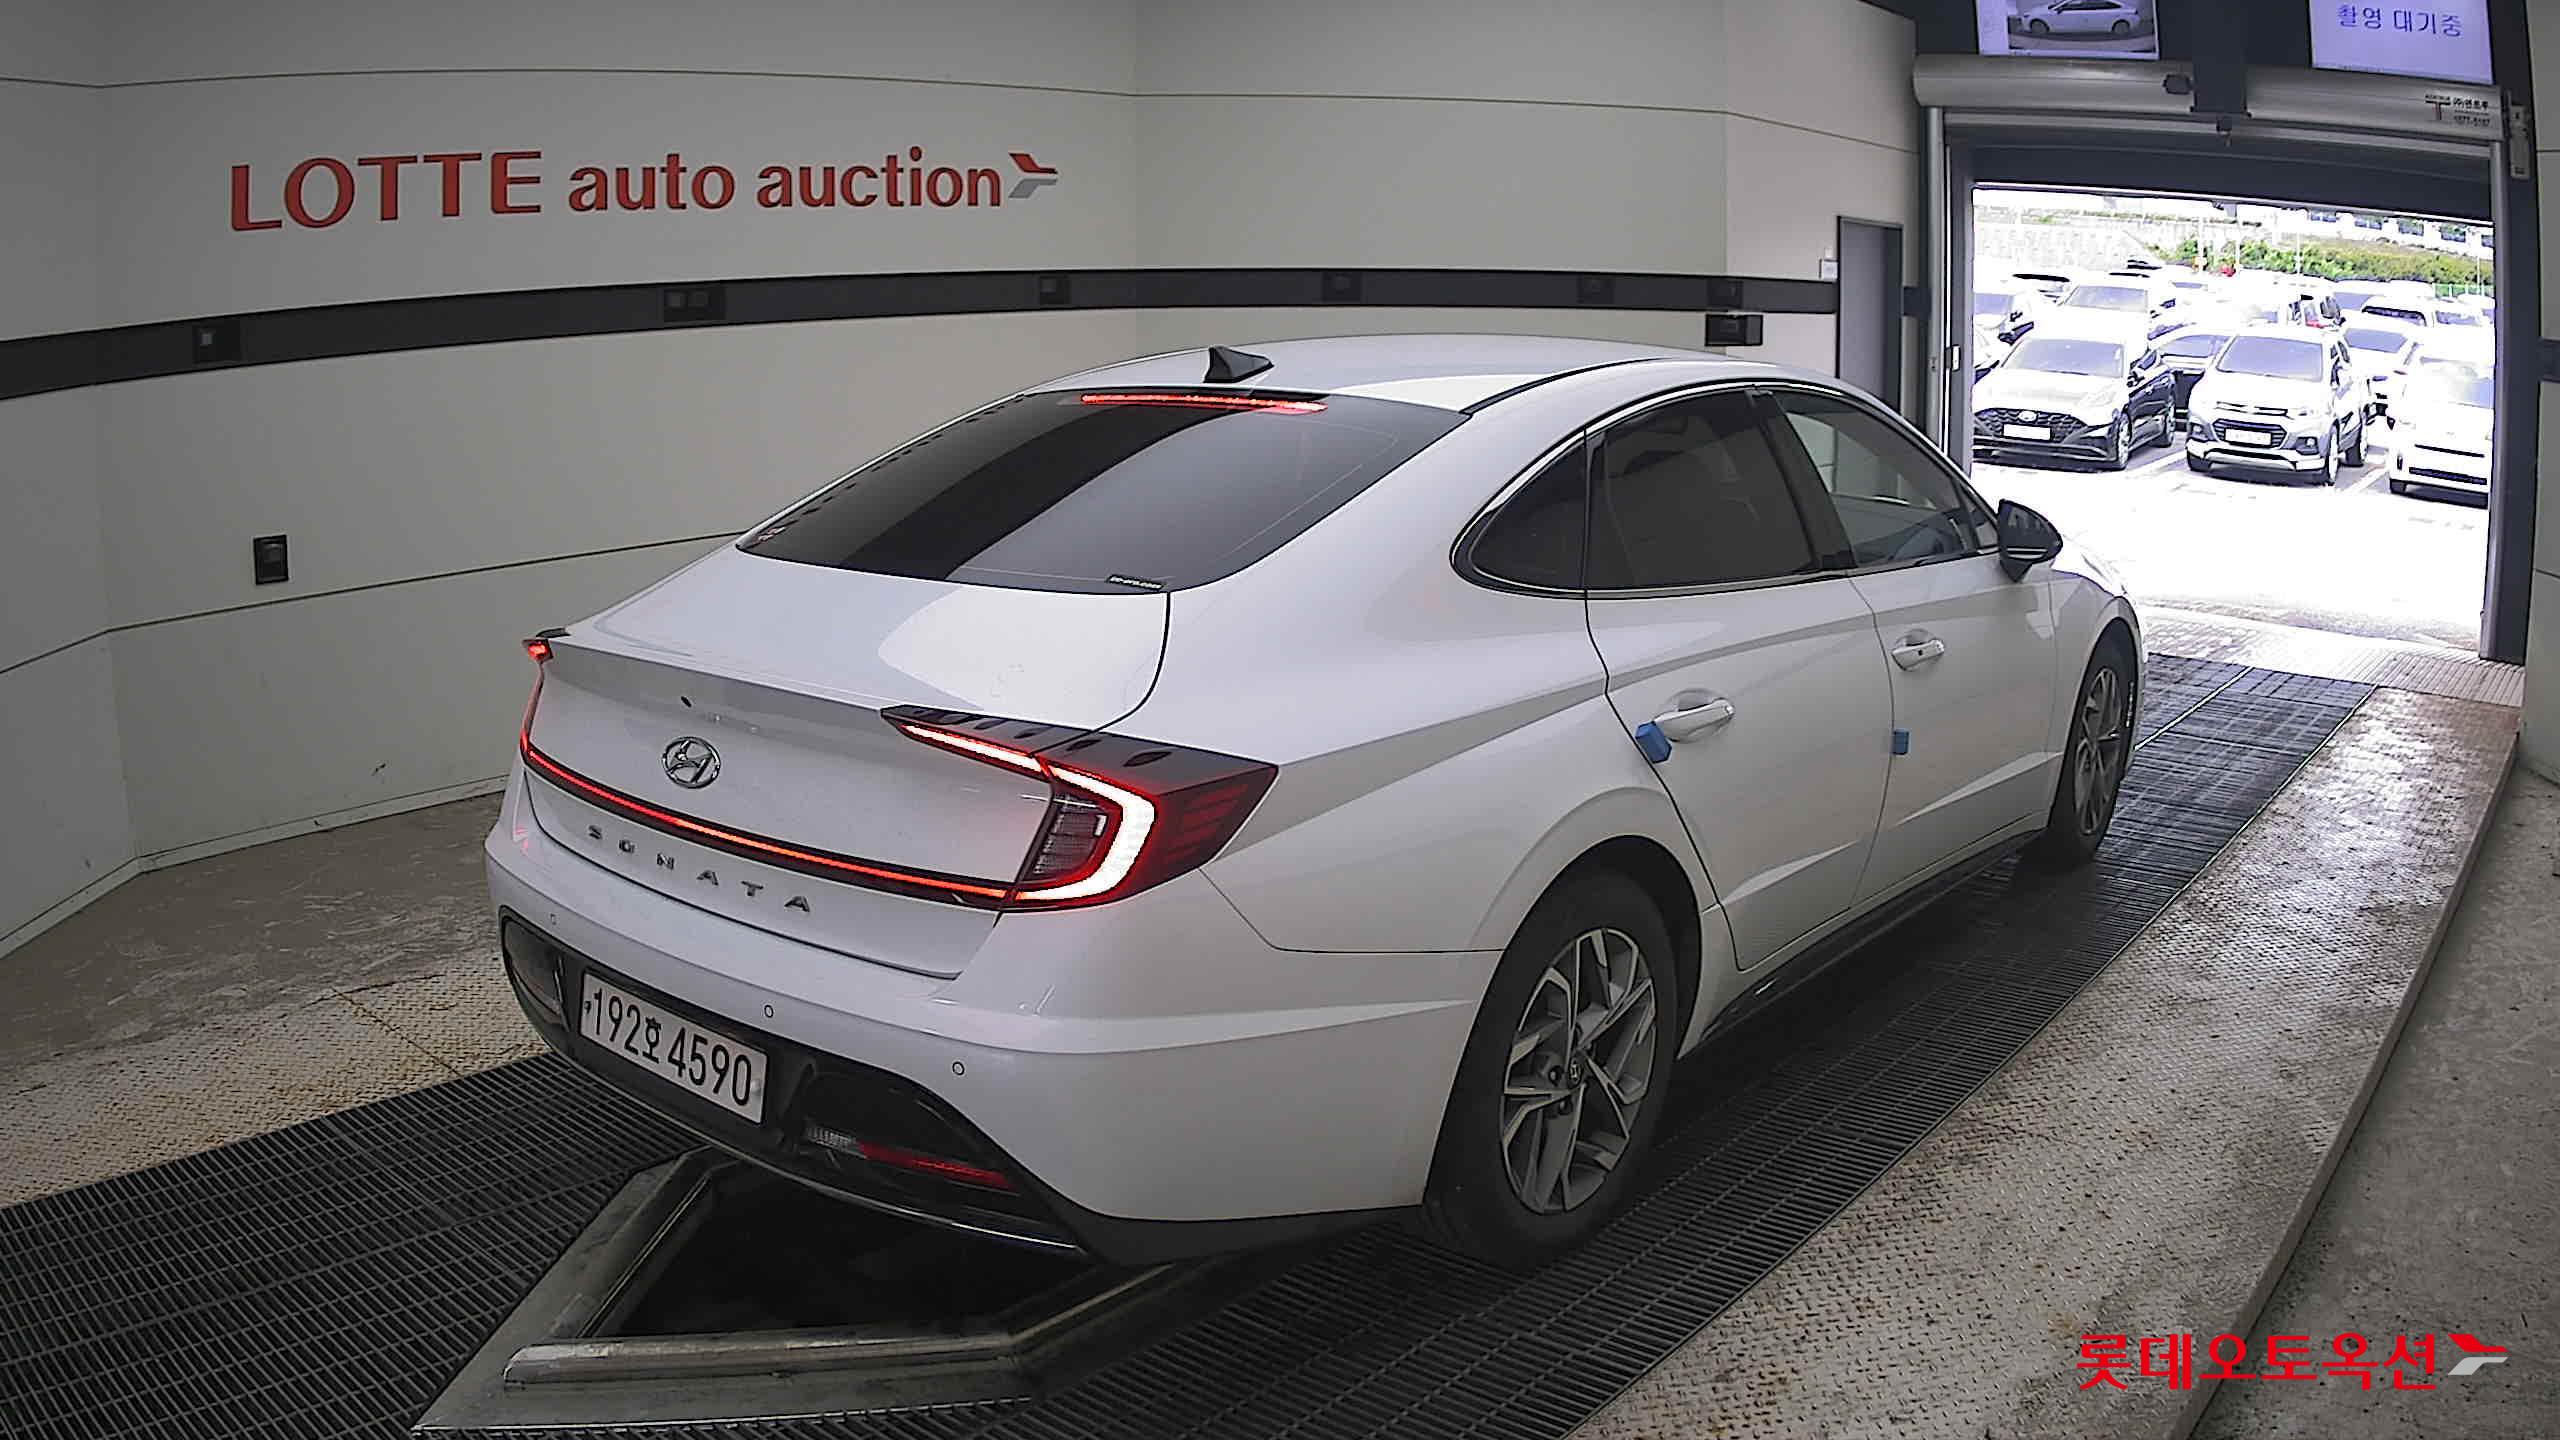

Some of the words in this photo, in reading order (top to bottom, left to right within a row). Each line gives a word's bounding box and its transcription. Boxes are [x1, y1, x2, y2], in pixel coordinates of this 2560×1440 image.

[2393, 9, 2462, 37] 대기중
[231, 151, 542, 232] LOTTE
[569, 153, 735, 211] auto
[757, 146, 1001, 208] auction
[588, 824, 810, 913] SONATA
